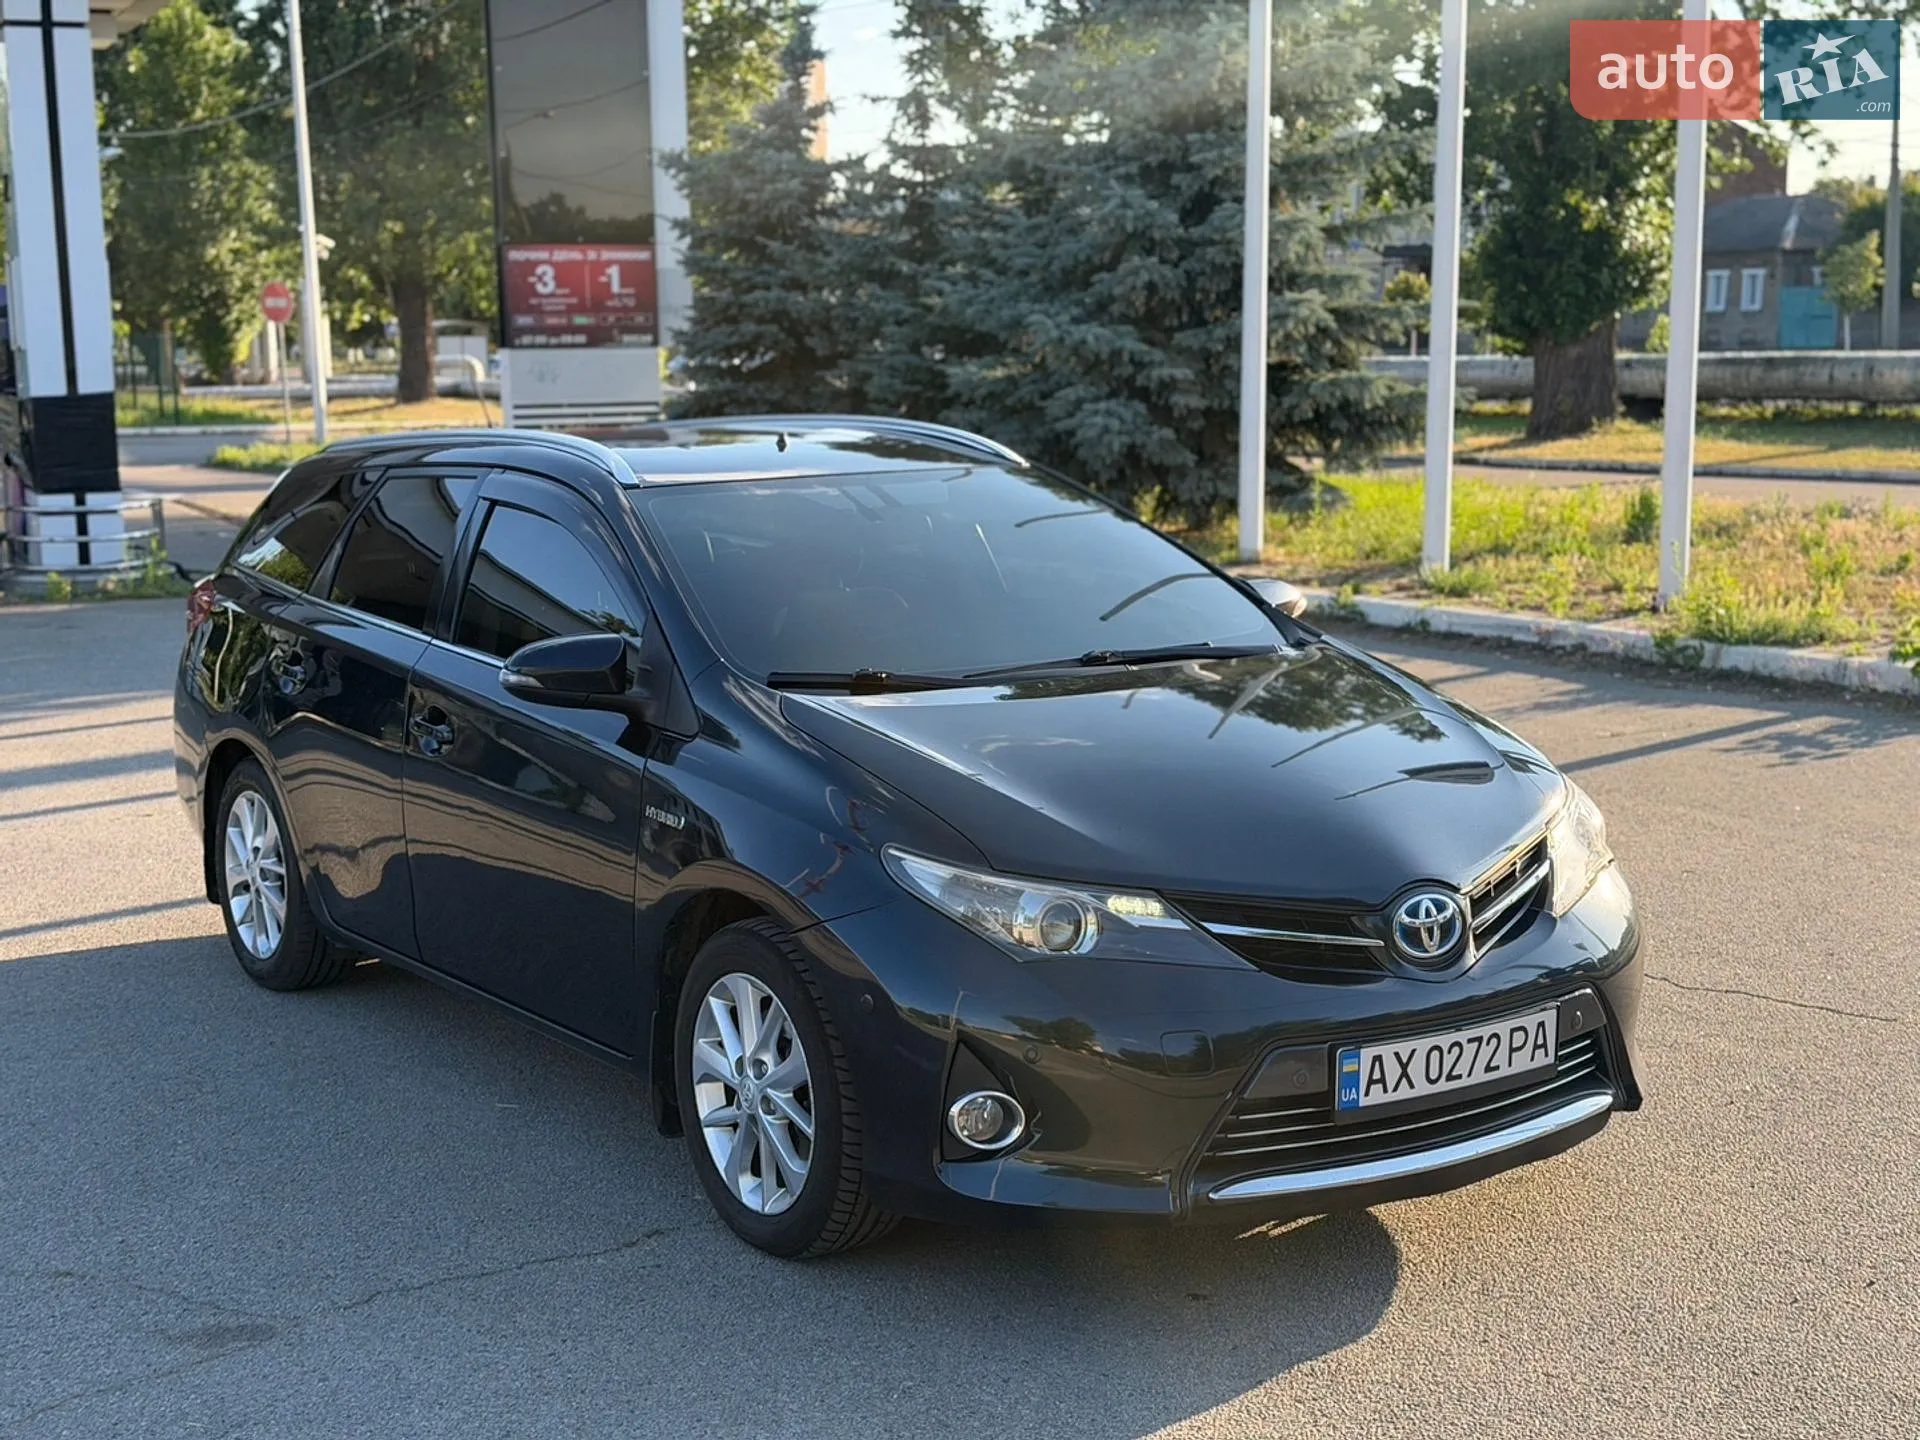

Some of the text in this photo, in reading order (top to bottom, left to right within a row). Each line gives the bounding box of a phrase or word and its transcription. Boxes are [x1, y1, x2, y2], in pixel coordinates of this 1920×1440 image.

[1363, 1019, 1550, 1097] AX 0272 PA
[1341, 1086, 1358, 1101] UA
